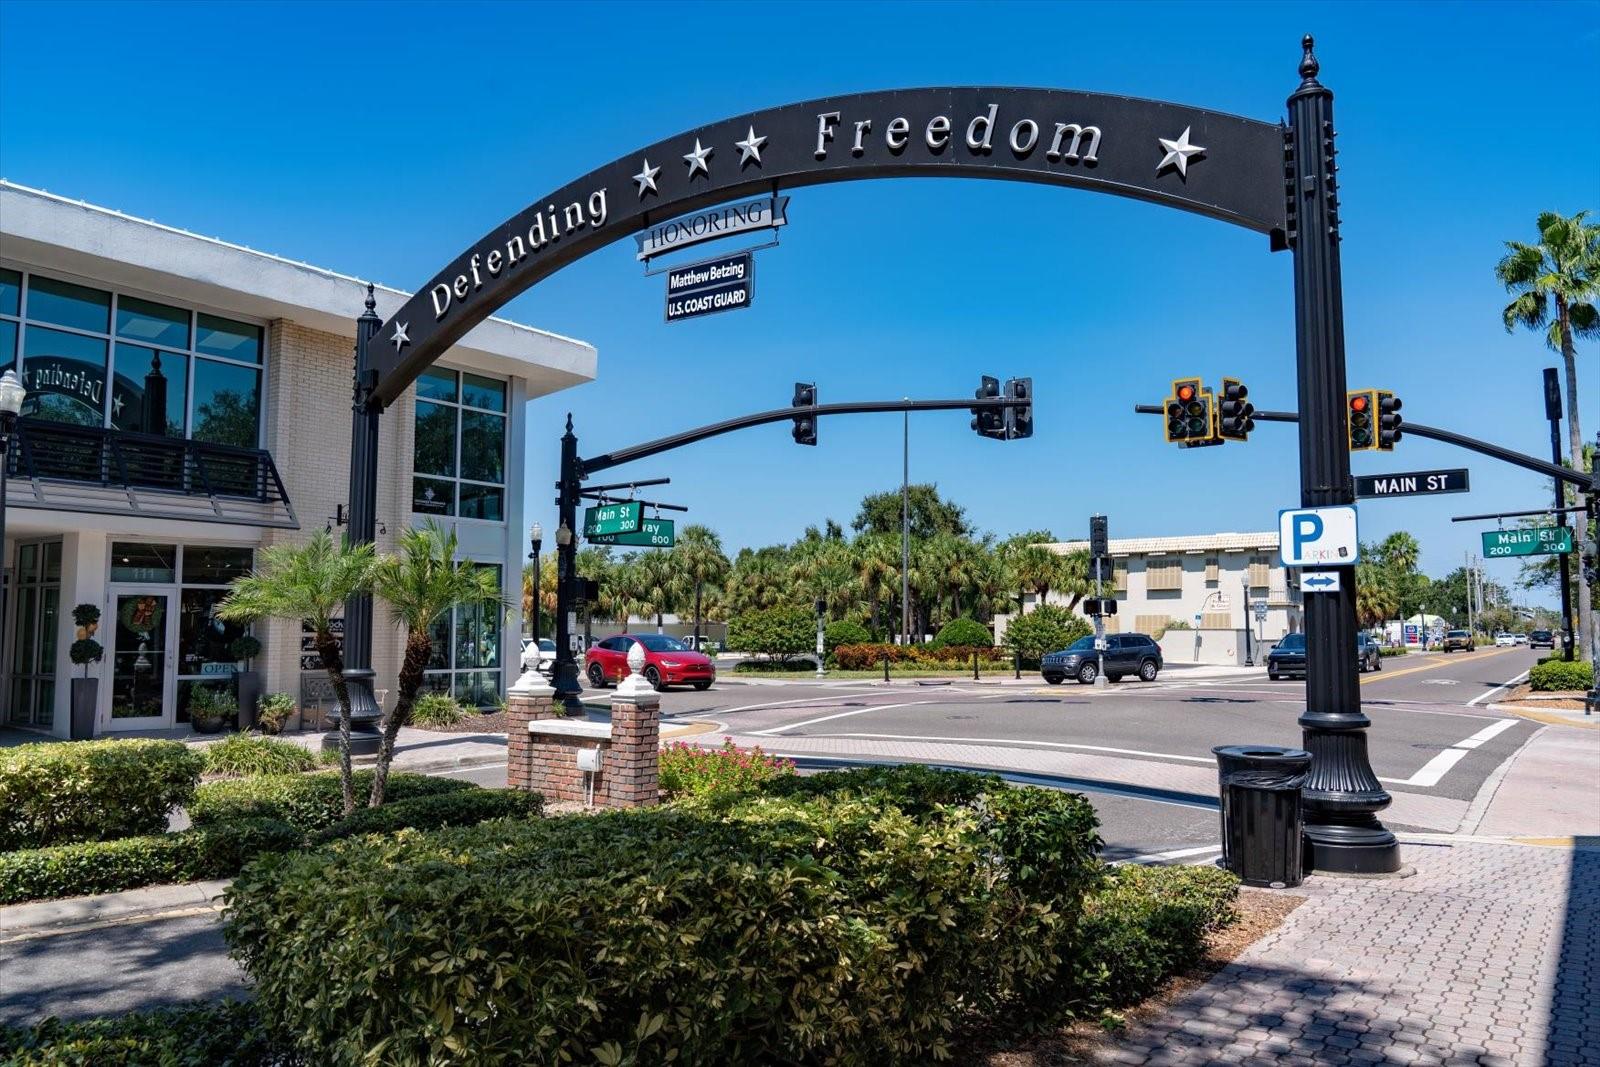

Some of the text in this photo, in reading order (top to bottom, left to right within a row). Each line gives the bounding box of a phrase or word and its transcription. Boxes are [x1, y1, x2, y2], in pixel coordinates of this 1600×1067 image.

[430, 103, 1104, 319] Defending Freedom
[651, 202, 762, 248] HONORING
[670, 262, 744, 289] Matthew Betzing
[668, 289, 745, 316] U.S. COAST GUARD
[1374, 474, 1448, 494] MAIN ST
[594, 506, 630, 520] Main St
[619, 519, 635, 530] 300
[651, 535, 669, 544] 800
[1498, 531, 1554, 544] Main St
[1490, 542, 1565, 555] 200 300
[204, 664, 239, 674] OPEN
